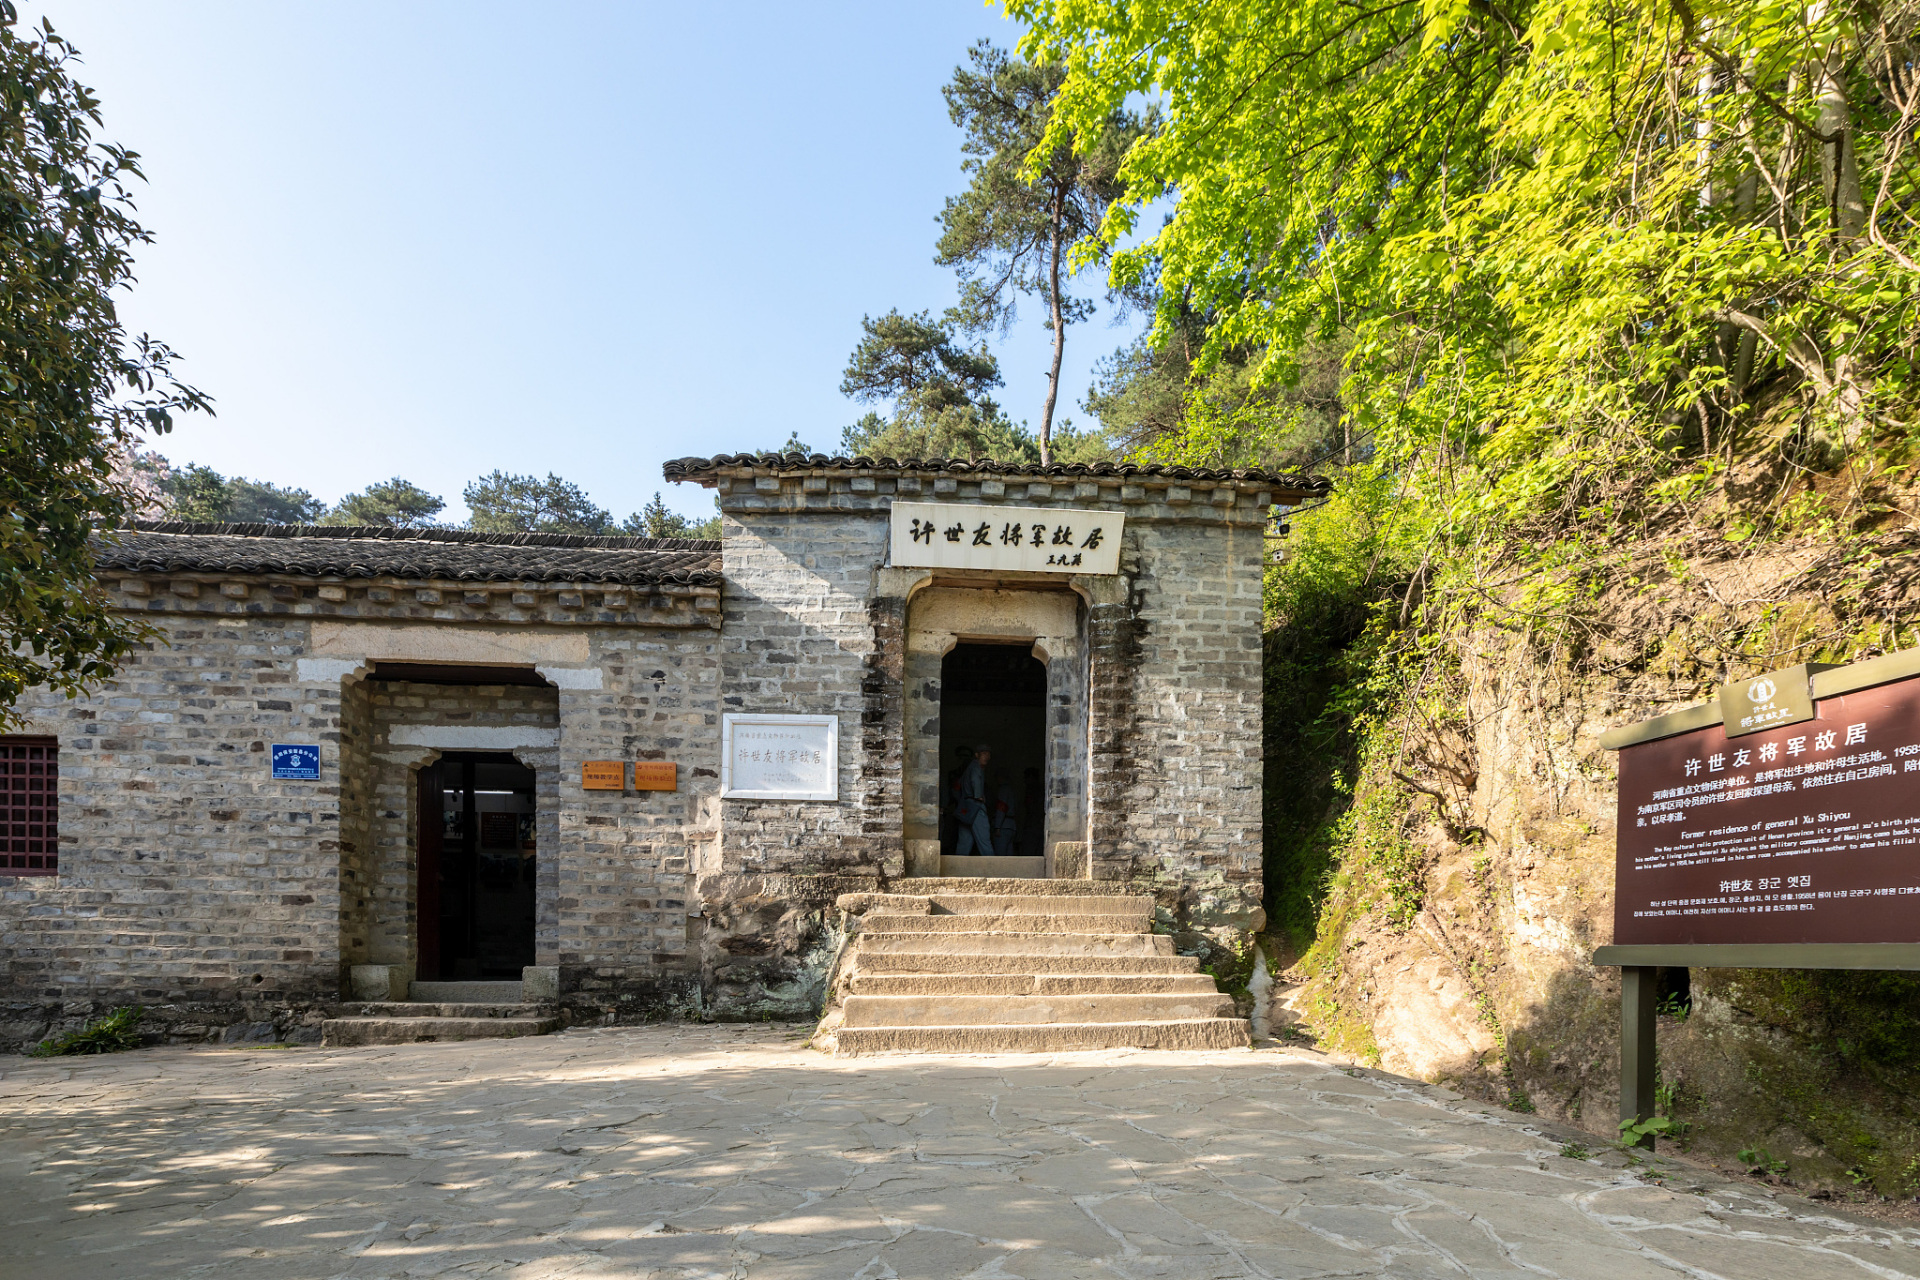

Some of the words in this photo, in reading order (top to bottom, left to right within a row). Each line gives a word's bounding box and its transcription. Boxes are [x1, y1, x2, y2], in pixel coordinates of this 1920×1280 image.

[909, 518, 1104, 549] 许世友将军故居
[738, 748, 821, 765] 许世友将军故居
[1684, 722, 1868, 777] 许世友将军故居
[1681, 830, 1705, 840] Former
[1709, 826, 1748, 836] residence
[1751, 821, 1762, 830] of
[1764, 817, 1798, 830] general
[1802, 815, 1814, 824] Xu
[1817, 812, 1850, 822] Shiyou
[1881, 819, 1902, 828] birth
[1892, 828, 1910, 836] back
[1719, 879, 1753, 893] 许世友
[1758, 877, 1781, 890] 장군
[1787, 875, 1811, 888] 옛집
